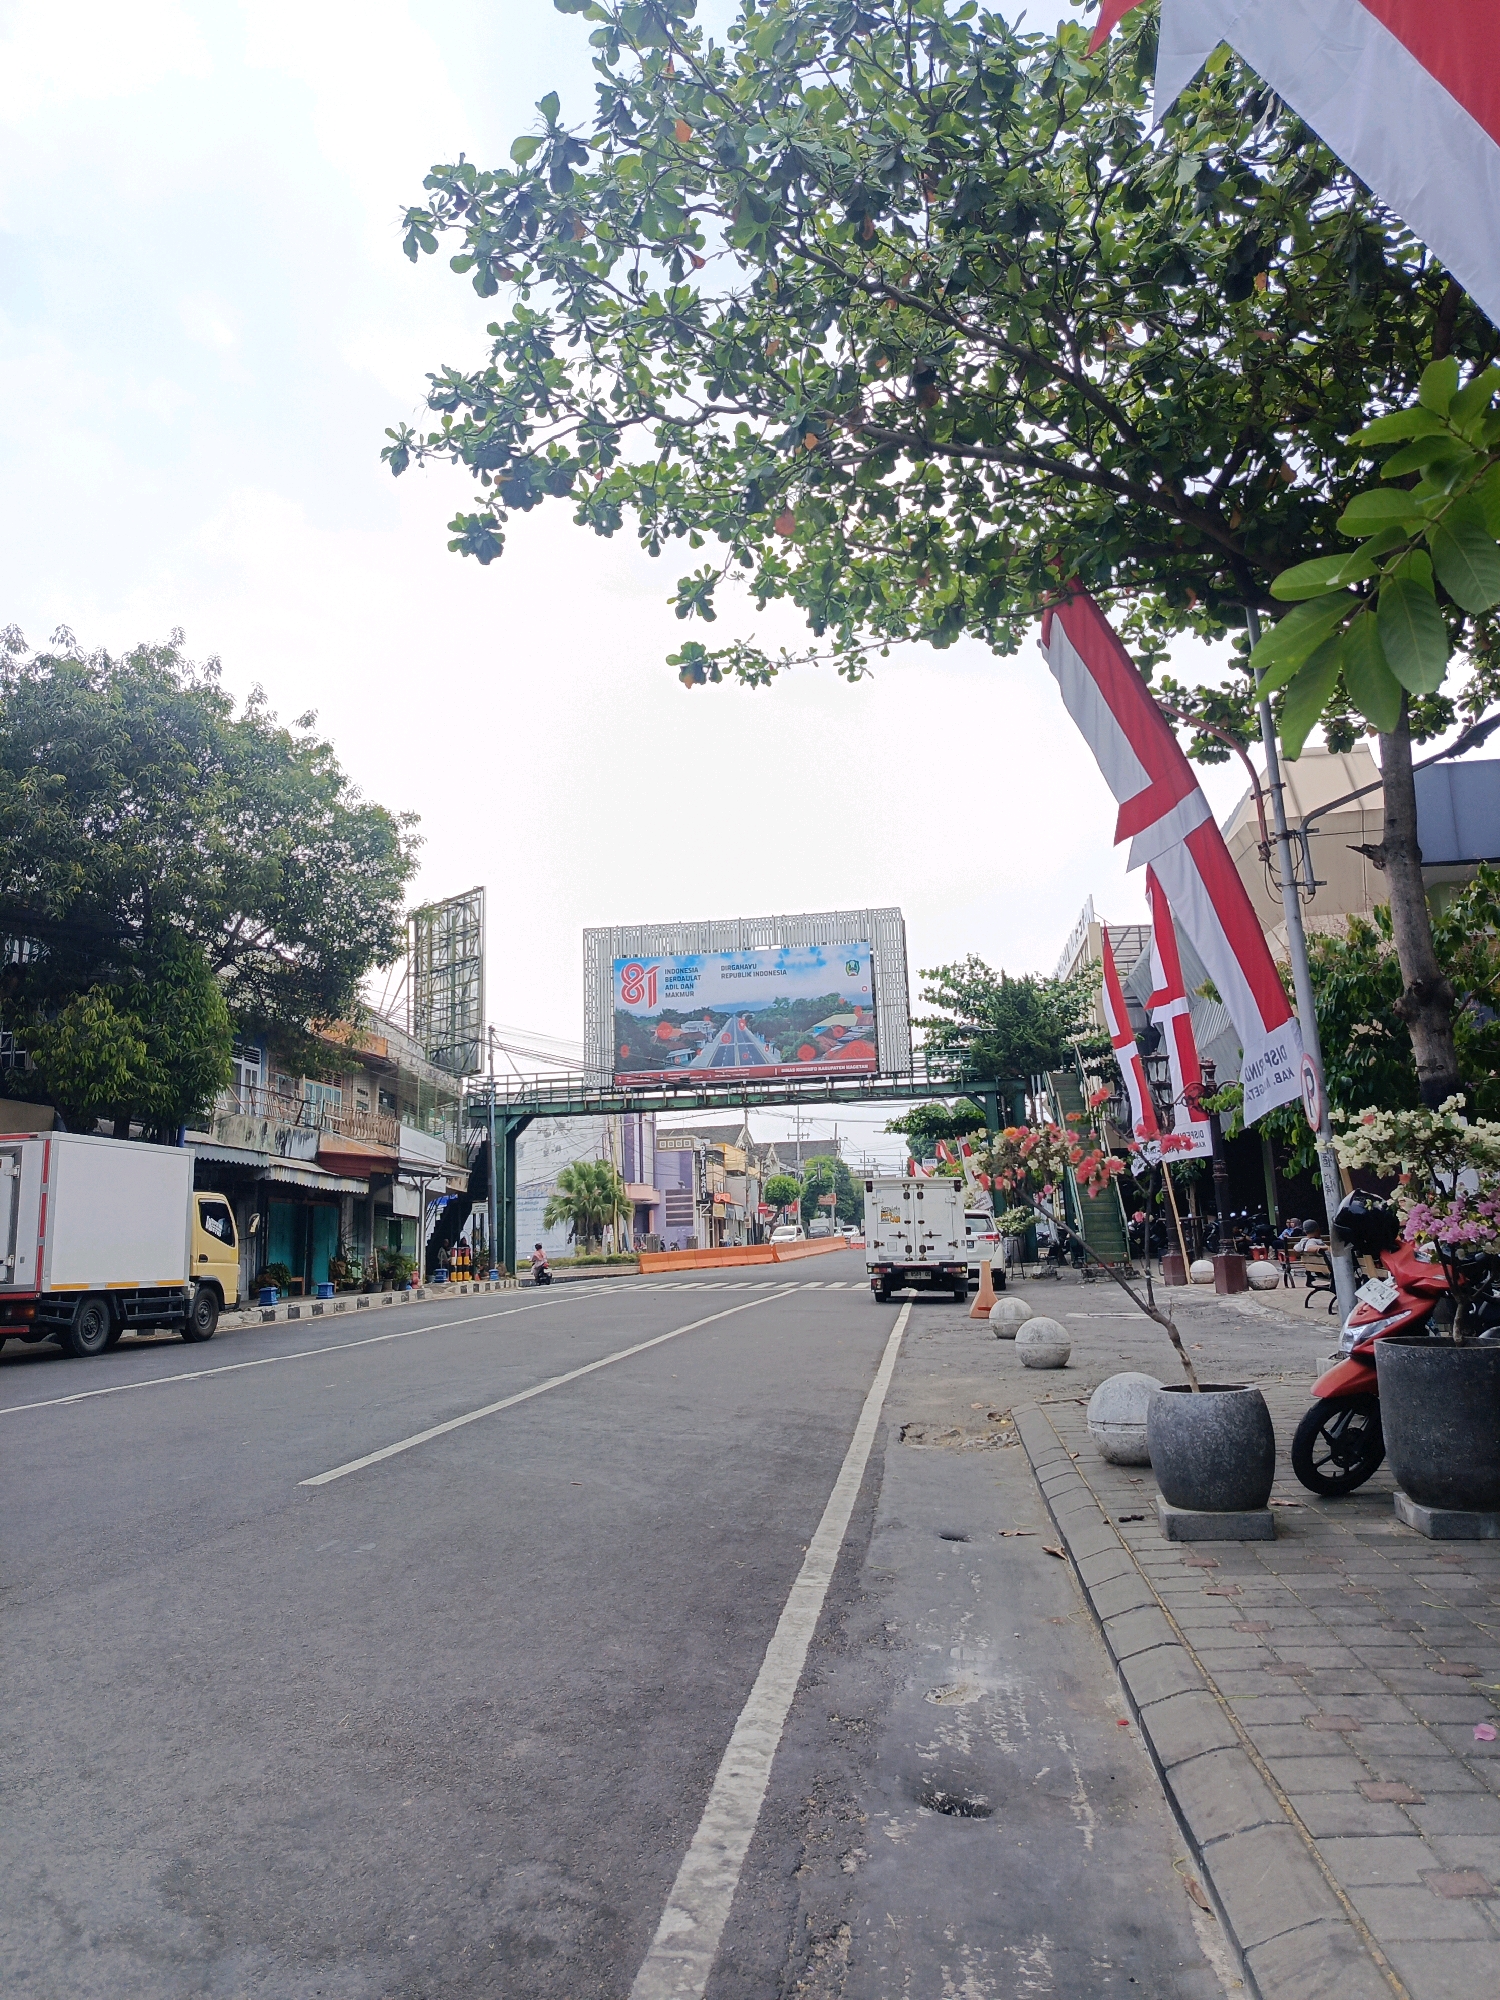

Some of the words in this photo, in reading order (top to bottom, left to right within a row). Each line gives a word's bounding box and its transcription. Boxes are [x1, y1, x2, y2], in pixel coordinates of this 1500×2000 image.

[665, 967, 699, 975] INDONESIA
[721, 963, 757, 972] DIRGAHAYU
[721, 971, 752, 979] REPUBLIK
